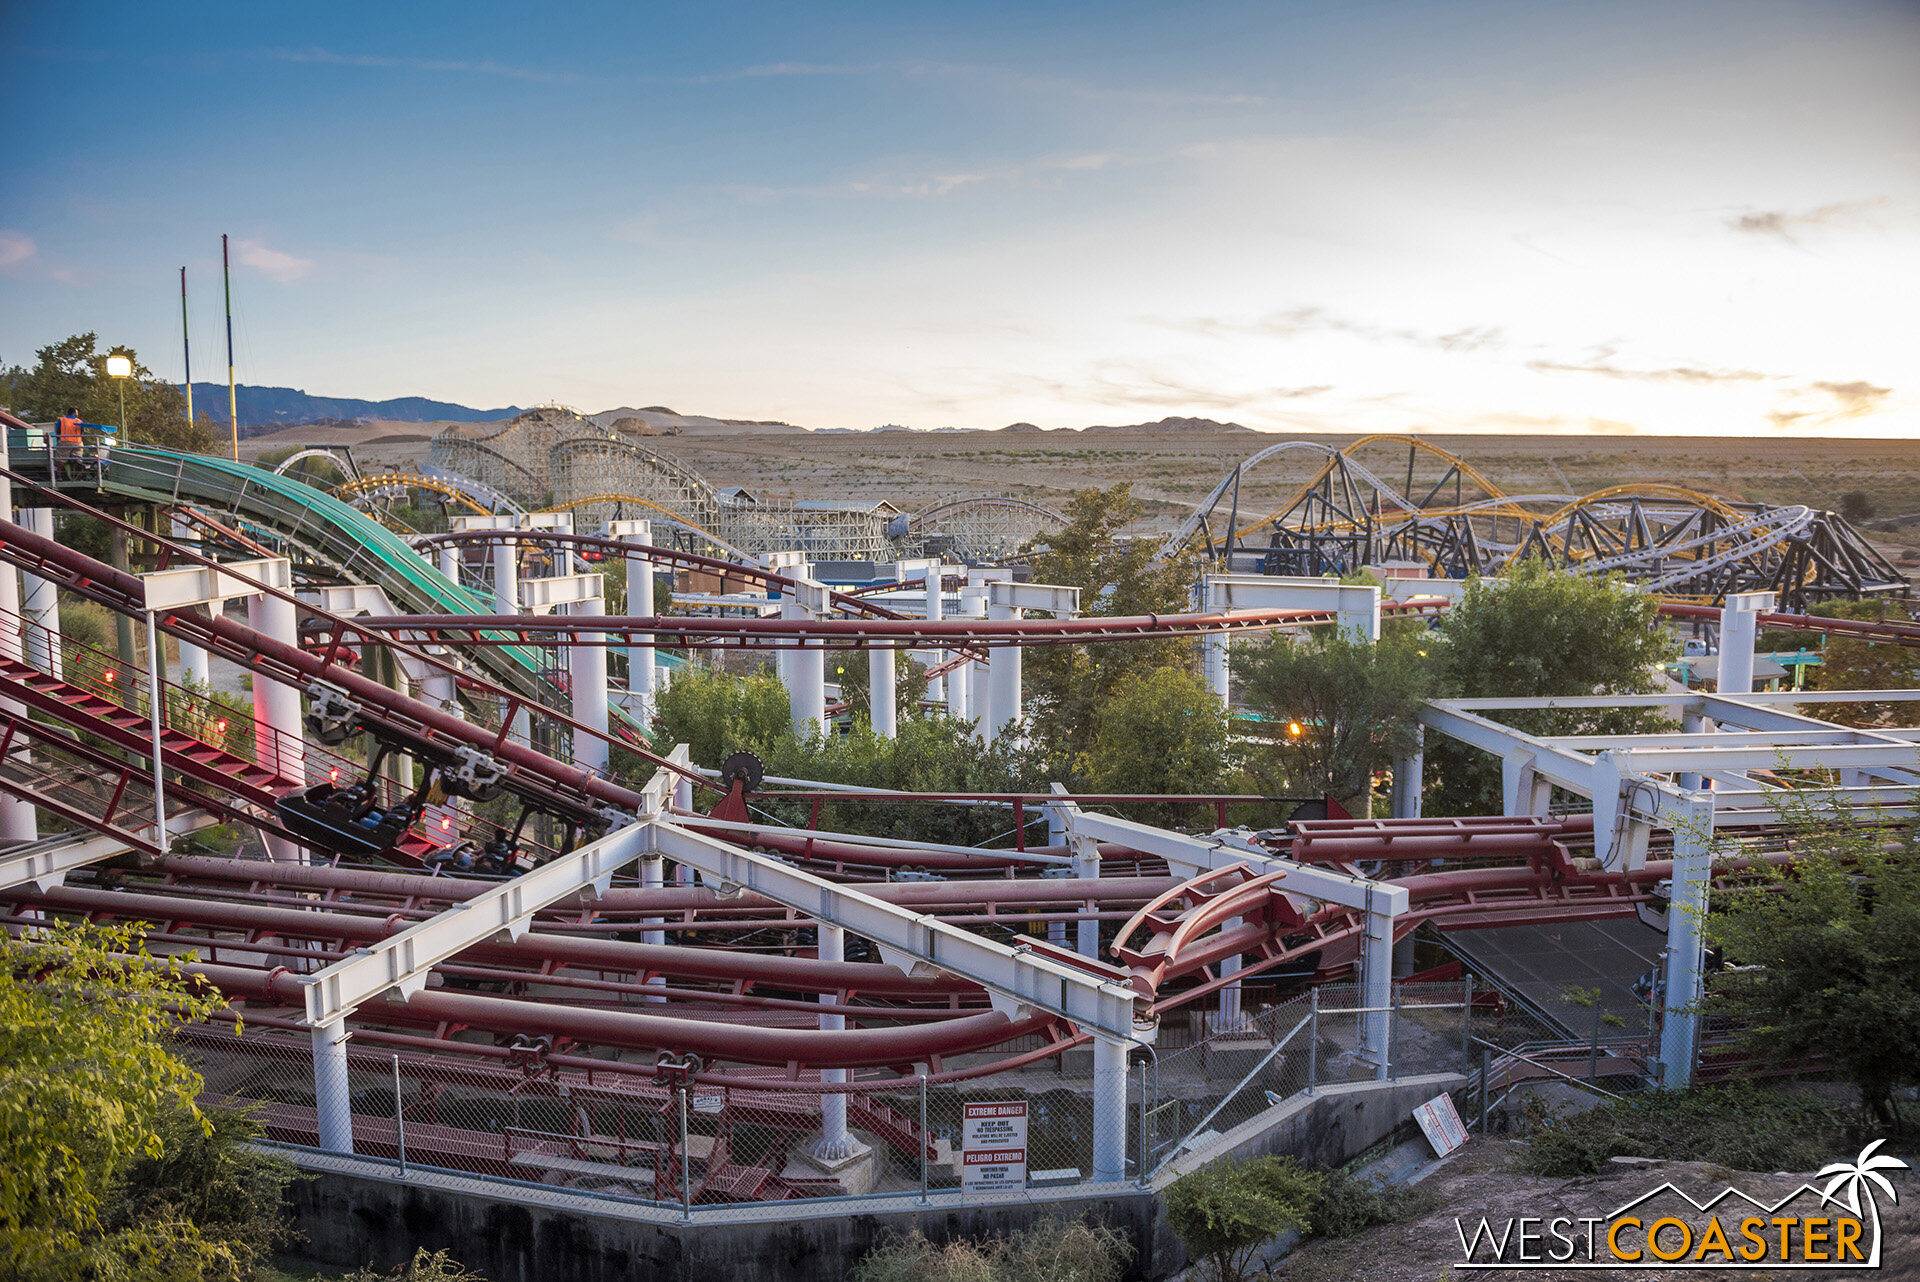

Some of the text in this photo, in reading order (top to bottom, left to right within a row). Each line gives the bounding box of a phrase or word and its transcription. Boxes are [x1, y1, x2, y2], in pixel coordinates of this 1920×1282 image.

[968, 1106, 1023, 1116] EXTREME DANGER
[966, 1152, 1023, 1163] PELIGRO EXTREMO
